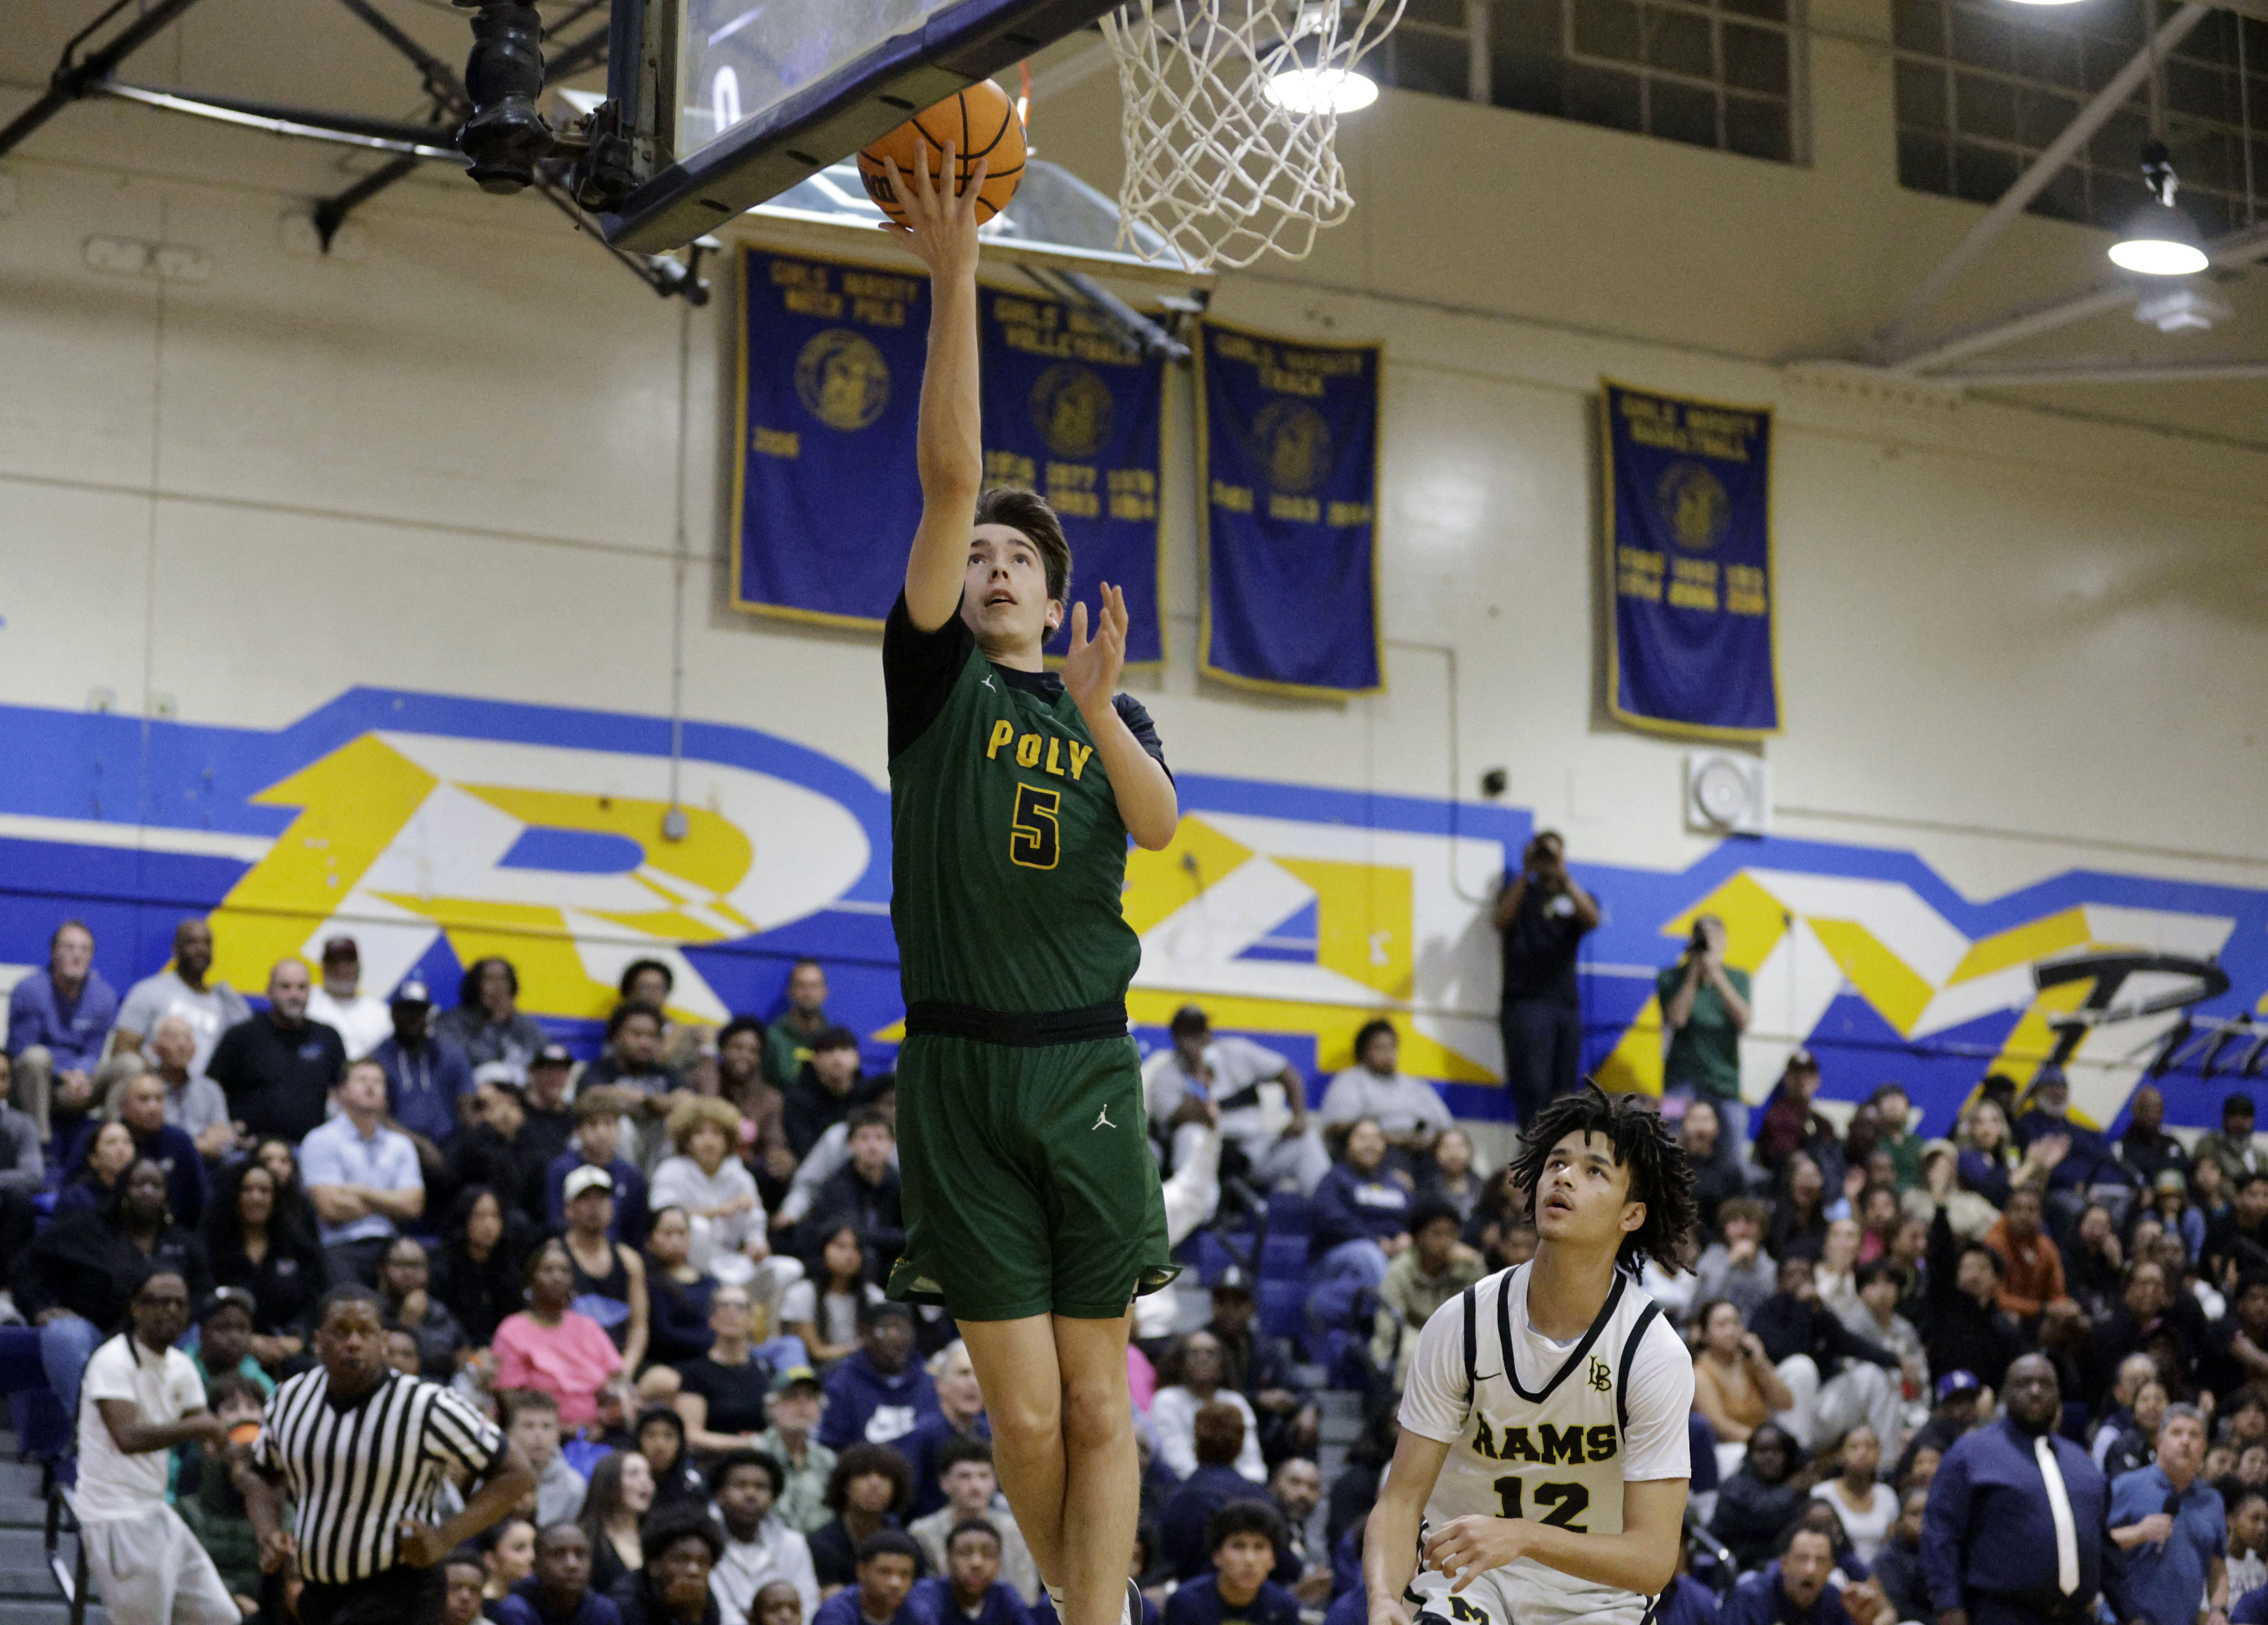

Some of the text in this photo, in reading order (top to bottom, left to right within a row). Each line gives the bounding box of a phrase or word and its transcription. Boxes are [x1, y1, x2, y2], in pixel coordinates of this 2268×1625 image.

[987, 719, 1093, 781] POLY
[1010, 782, 1060, 870] 5
[156, 727, 2268, 1133] RAM
[1472, 1411, 1618, 1465] RAMS
[1494, 1476, 1589, 1534] 12
